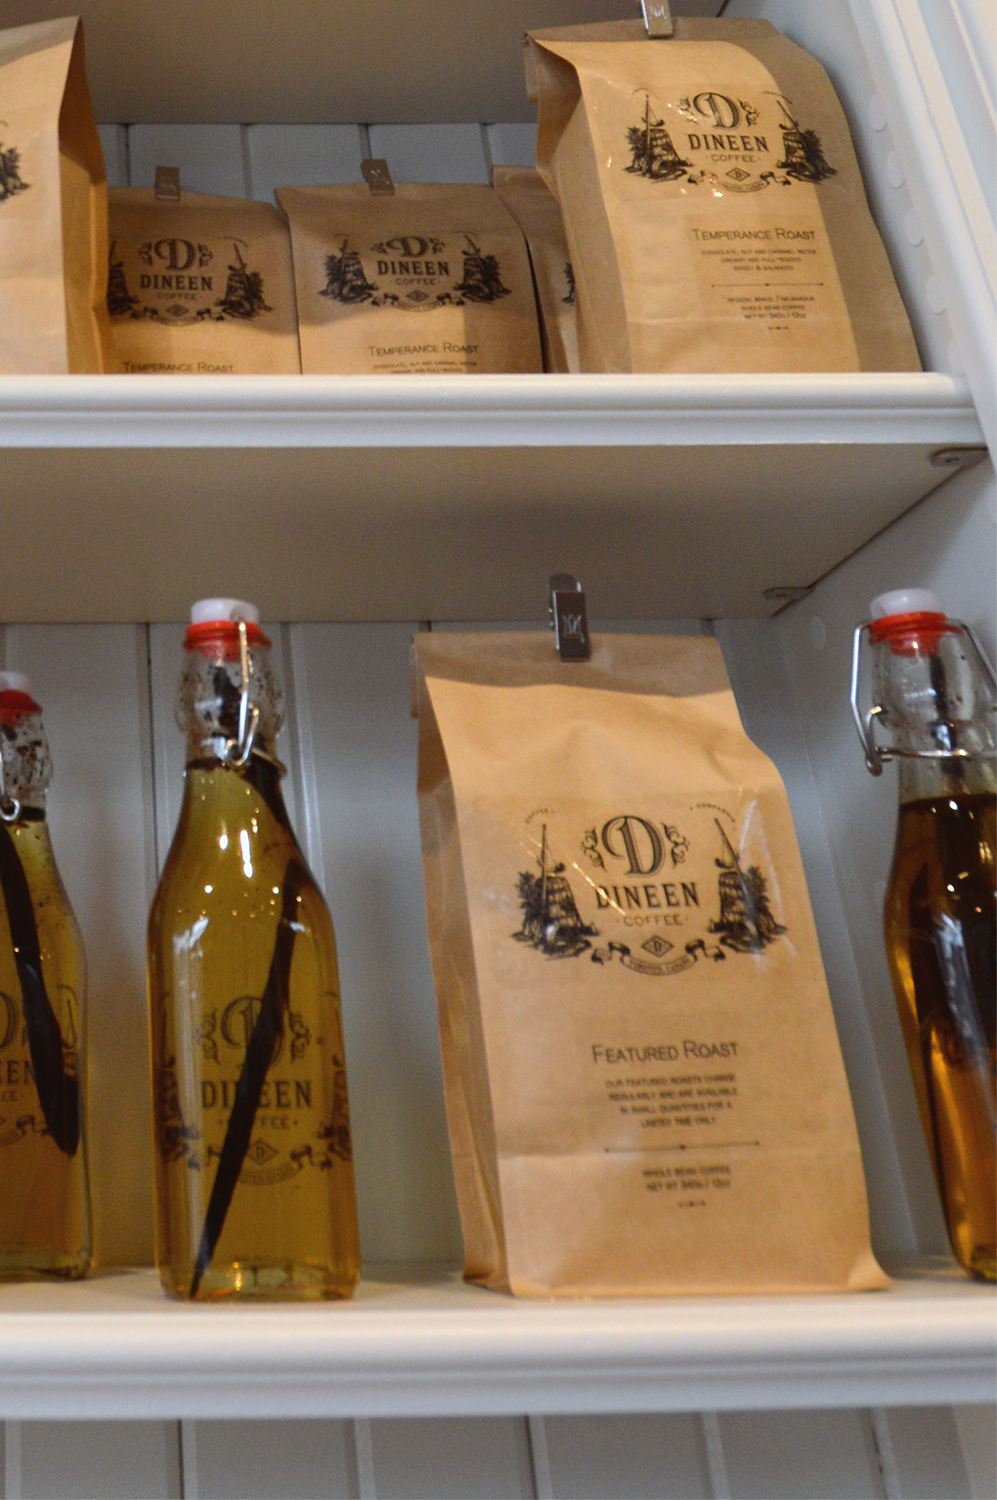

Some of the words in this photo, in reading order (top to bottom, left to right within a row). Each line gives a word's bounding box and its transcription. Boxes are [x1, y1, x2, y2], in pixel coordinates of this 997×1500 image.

[693, 92, 742, 130] D
[687, 133, 770, 152] DINEEN
[711, 153, 757, 162] COFFEE
[691, 228, 772, 241] TEMPERANCE
[775, 228, 816, 240] ROAST
[155, 238, 196, 271] D
[387, 236, 428, 258] D
[377, 260, 451, 277] DINEEN
[140, 274, 213, 291] DINEEN
[395, 276, 436, 286] COFFEE
[156, 291, 197, 300] COFFEE
[368, 344, 439, 357] TEMPERANCE
[442, 342, 479, 355] ROAST
[122, 361, 193, 373] TEMPERANCE
[197, 361, 235, 373] ROAST
[602, 815, 666, 878] D
[596, 882, 700, 910] DINEEN
[623, 913, 683, 927] COFFEE
[592, 1044, 680, 1064] FEATURED
[683, 1039, 738, 1059] ROAST
